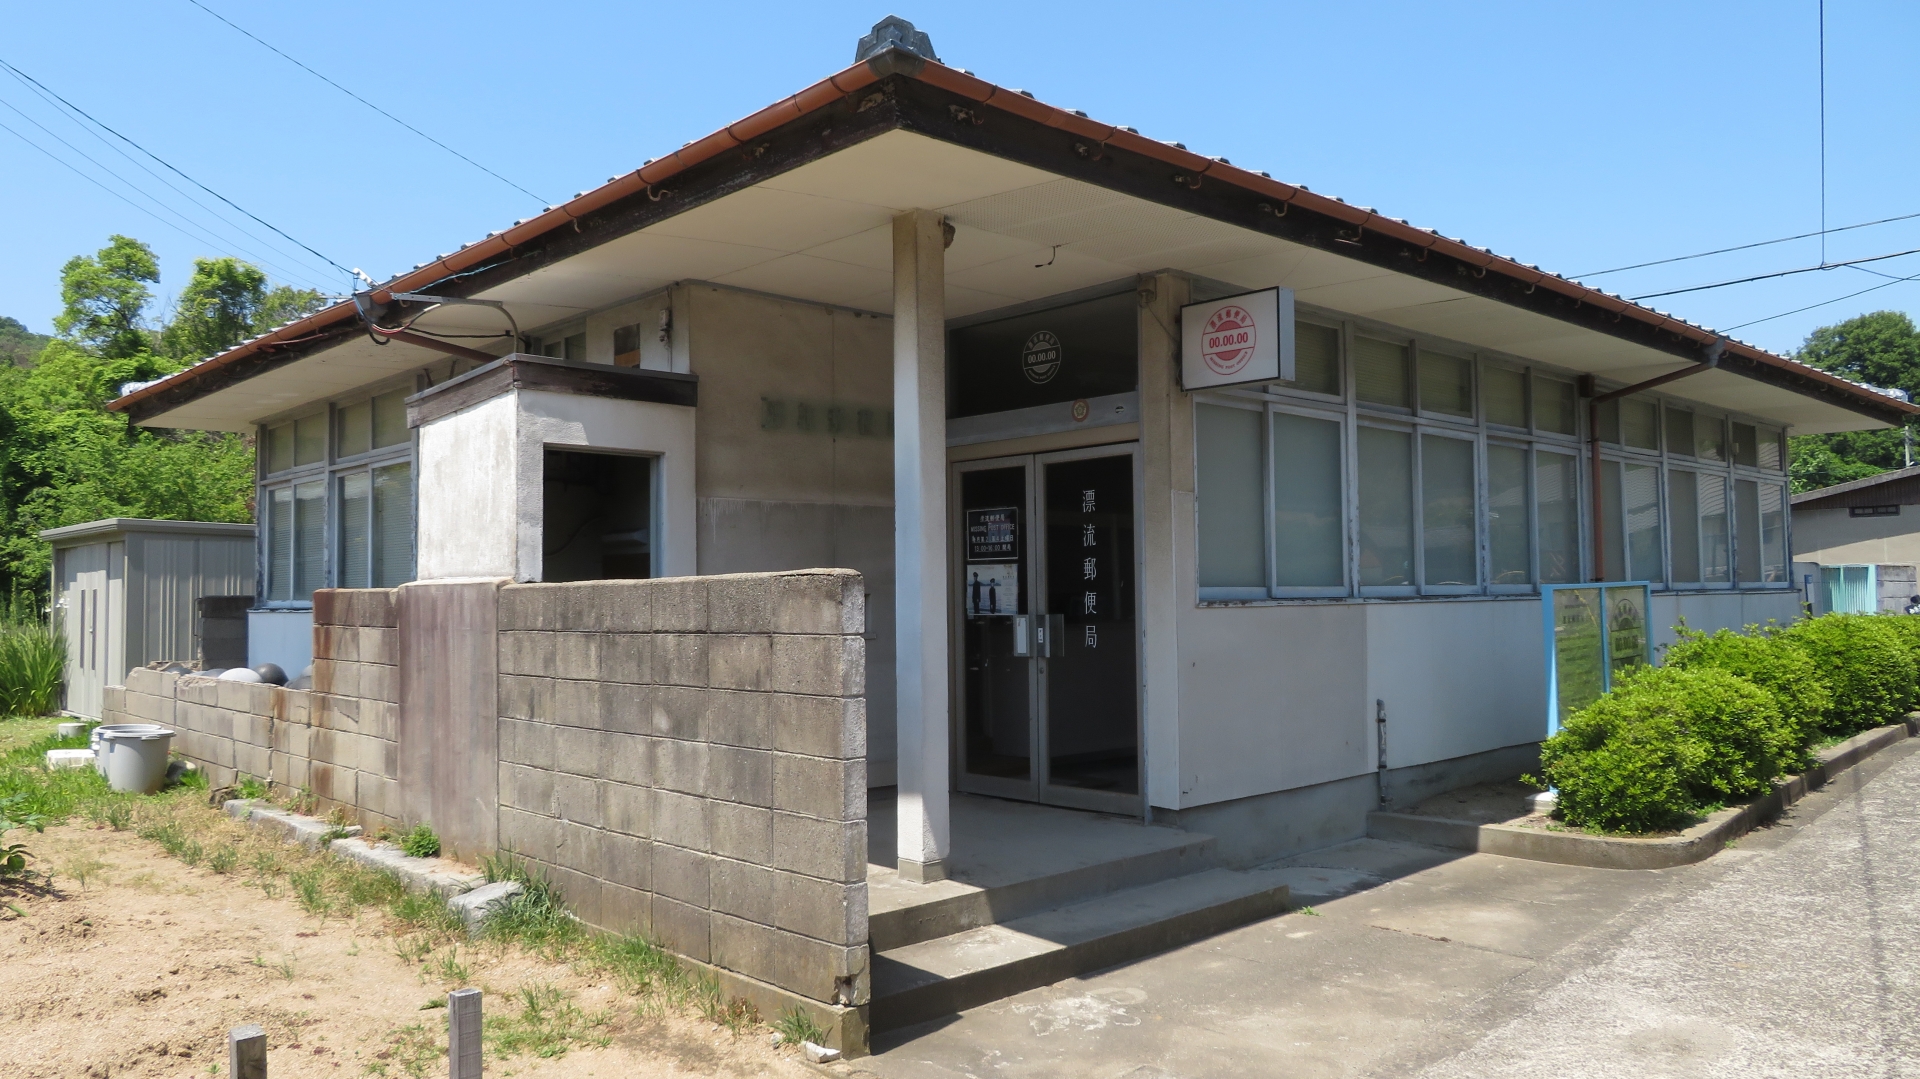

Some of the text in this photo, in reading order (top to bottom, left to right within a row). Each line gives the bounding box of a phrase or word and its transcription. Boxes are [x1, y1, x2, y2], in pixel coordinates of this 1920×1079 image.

[1209, 332, 1249, 349] 00.00.00
[1027, 350, 1056, 364] 00.00.00
[988, 523, 999, 531] POST
[1001, 523, 1015, 531] OFFICE
[1082, 489, 1098, 649] 漂流郵便局
